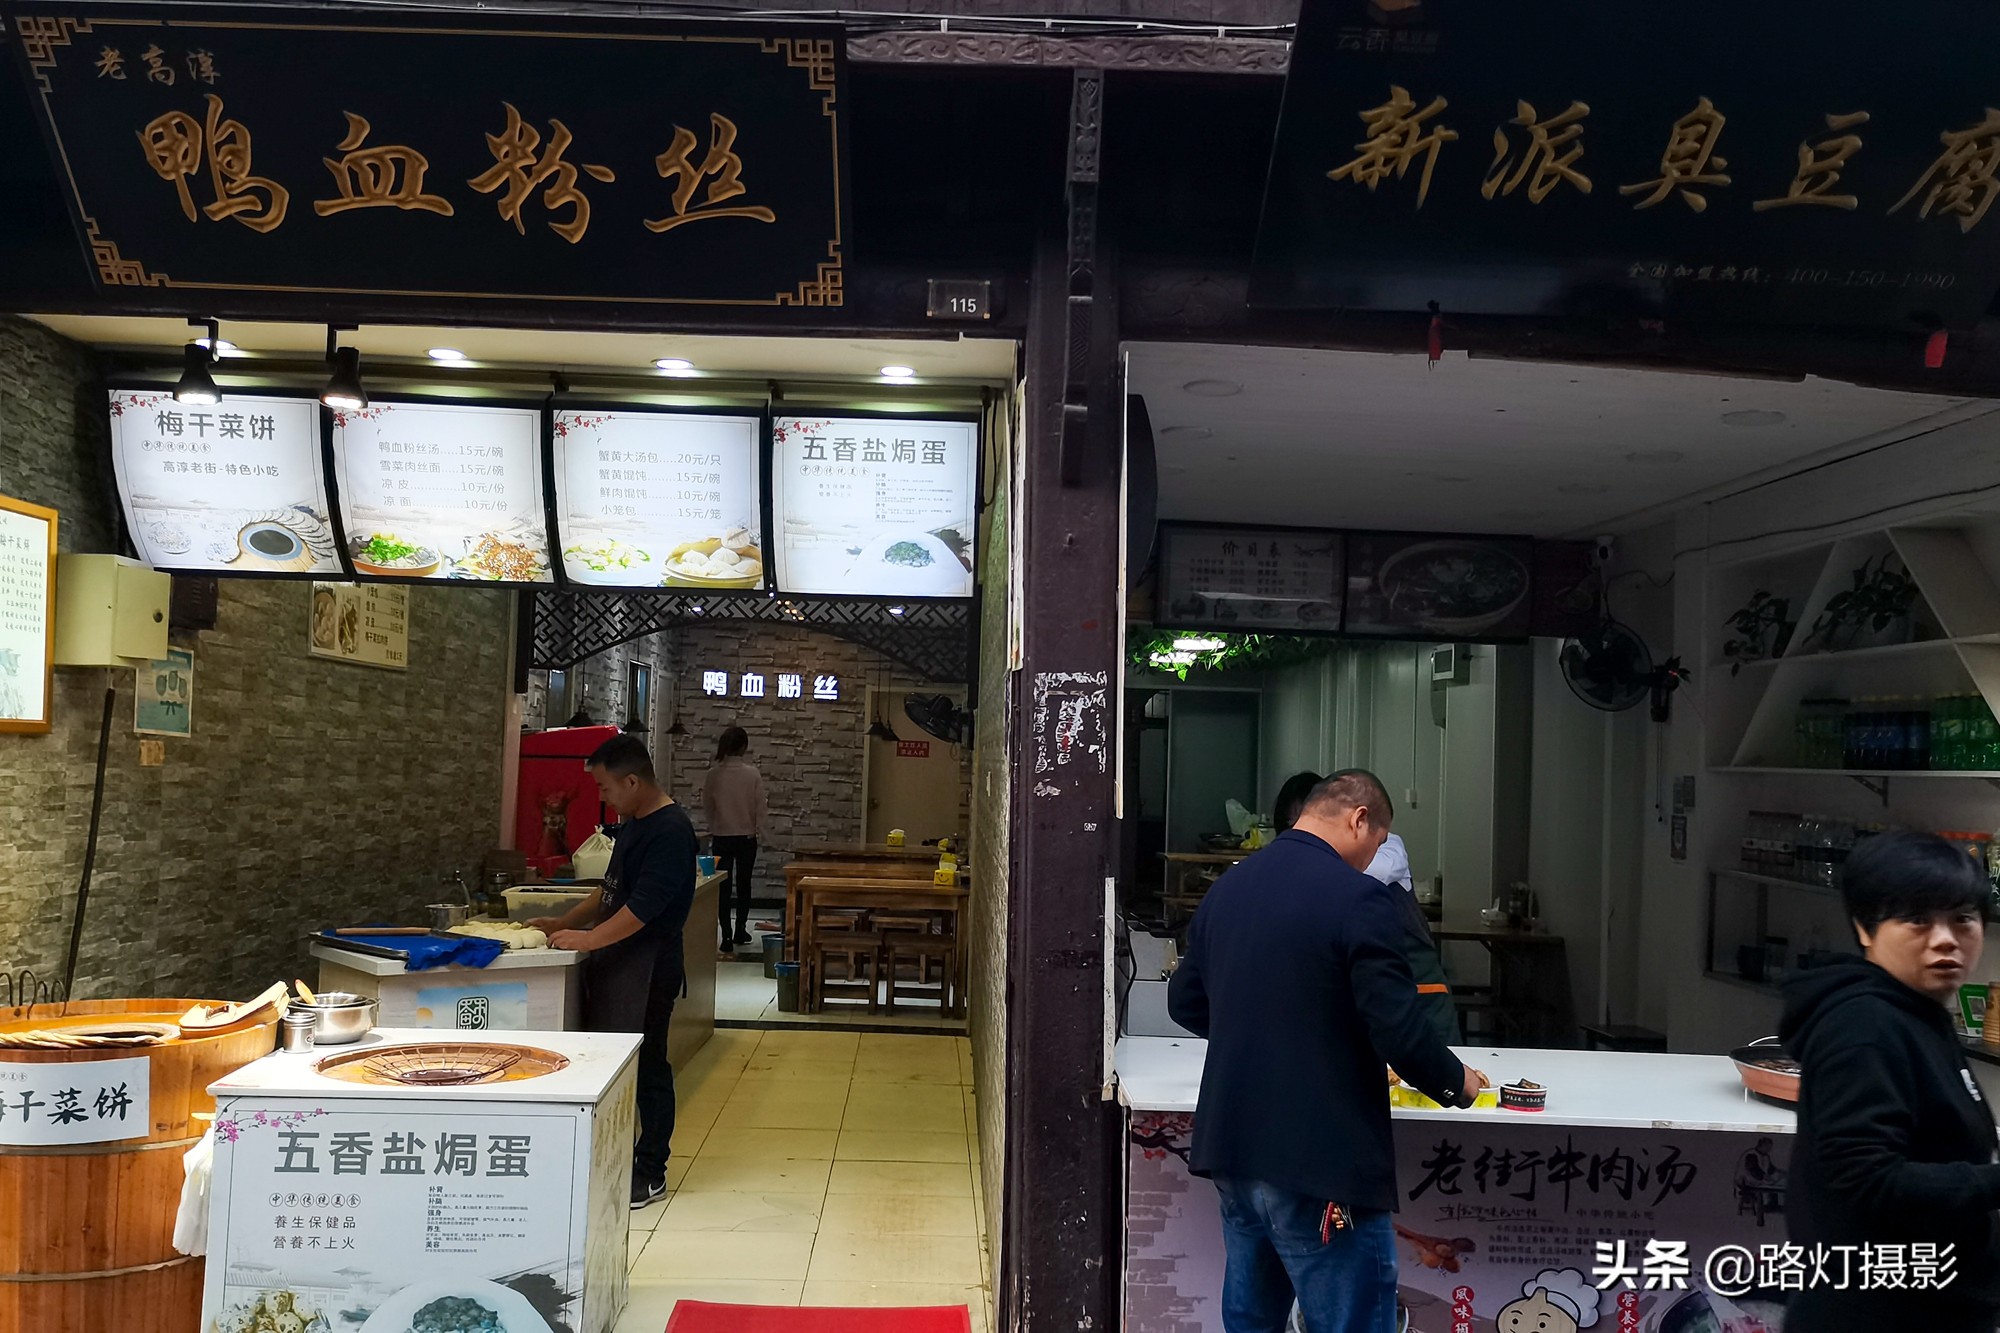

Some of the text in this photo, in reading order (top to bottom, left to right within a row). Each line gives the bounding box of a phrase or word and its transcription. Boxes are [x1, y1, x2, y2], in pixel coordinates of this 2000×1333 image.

[95, 46, 223, 86] 老高淳
[136, 95, 776, 244] 鸭血粉丝
[950, 298, 977, 313] 115
[156, 410, 275, 441] 梅干菜饼
[378, 441, 440, 455] 鸭血粉丝汤
[598, 450, 658, 464] 蟹黄大汤包
[802, 436, 947, 465] 五香盐焗蛋
[162, 461, 280, 477] 高淳老街-特色小吃
[380, 460, 441, 473] 雪菜肉丝面
[599, 487, 648, 500] 鲜肉馄饨
[601, 505, 637, 516] 小笼包
[703, 671, 838, 700] 鸭血粉丝
[0, 1082, 133, 1125] 干菜饼
[274, 1131, 531, 1178] 五香盐焗蛋
[1408, 1133, 1698, 1213] 老街牛肉汤
[269, 1193, 361, 1208] 中华传统美食
